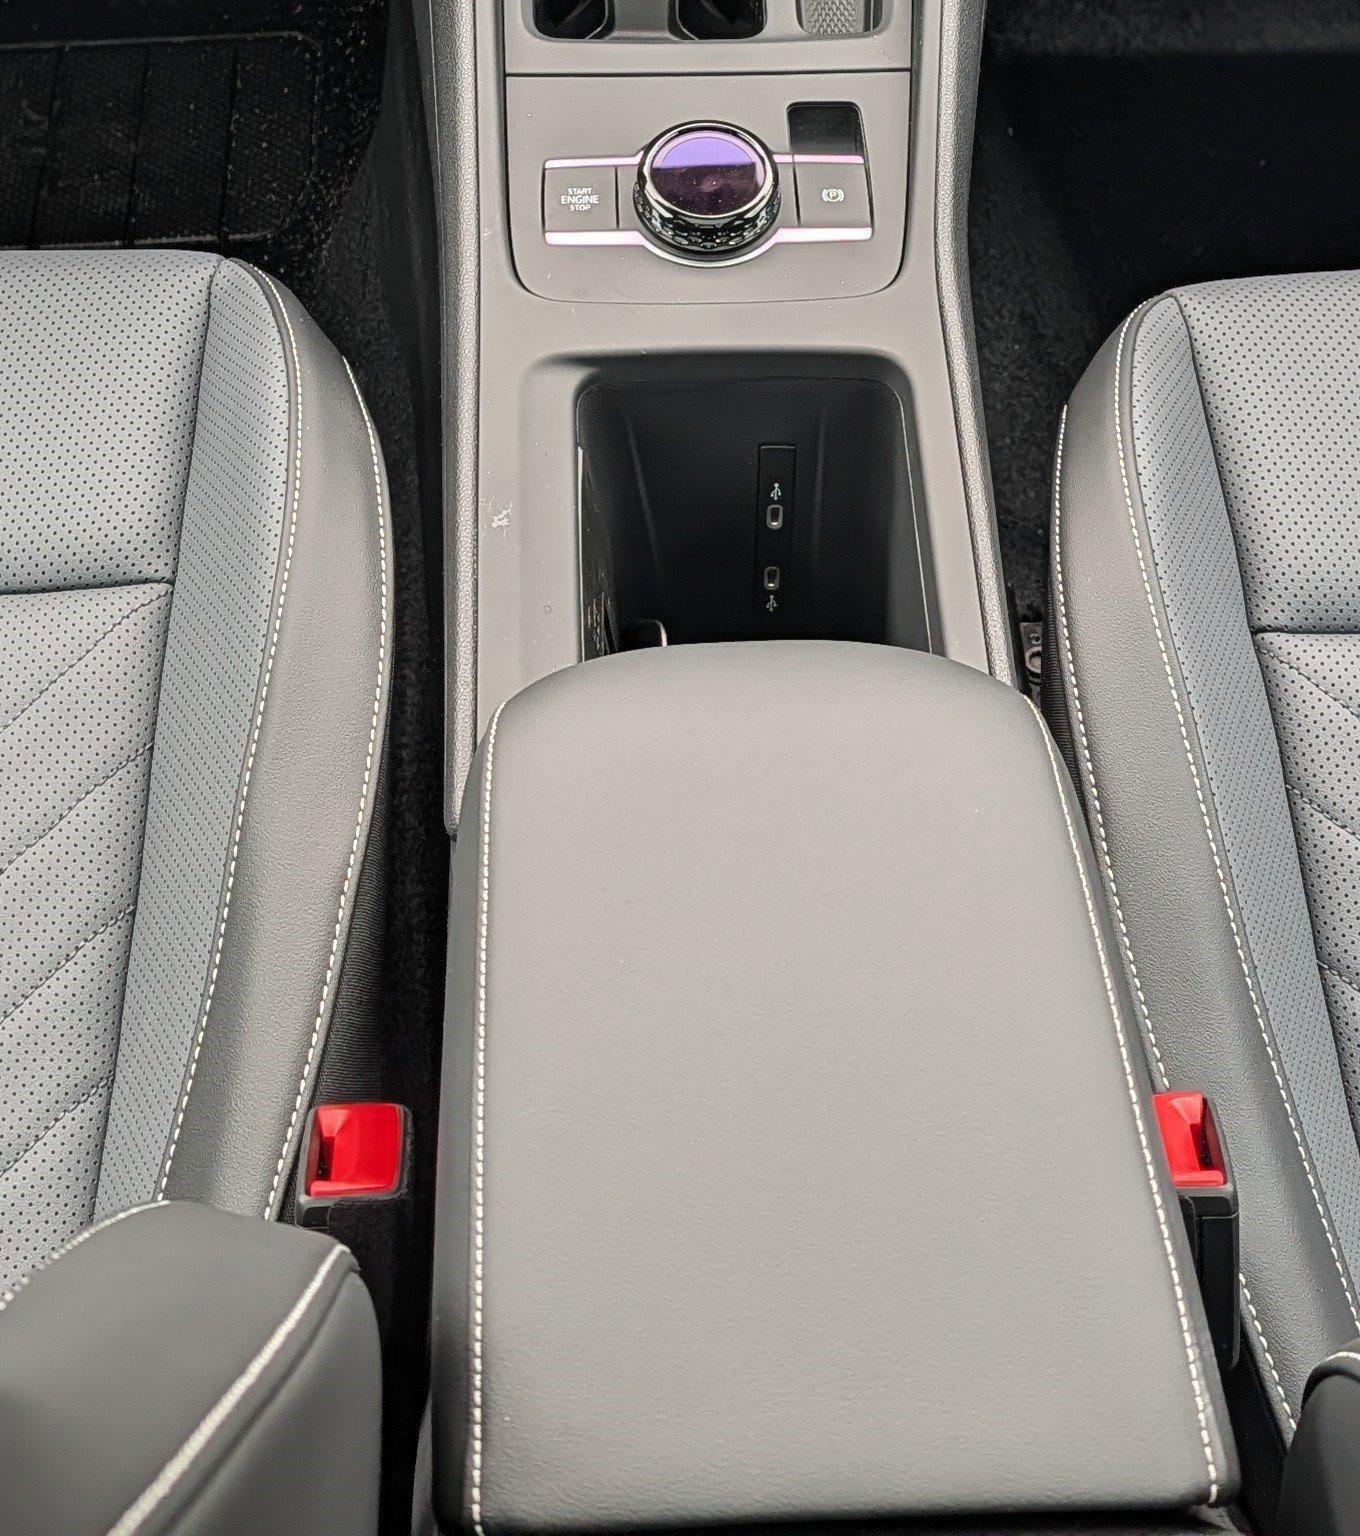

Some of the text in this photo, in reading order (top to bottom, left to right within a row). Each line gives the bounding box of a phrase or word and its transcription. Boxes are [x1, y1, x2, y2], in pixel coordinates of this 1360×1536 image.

[568, 187, 592, 195] START
[560, 195, 600, 205] ENGINE
[569, 203, 591, 212] STOP
